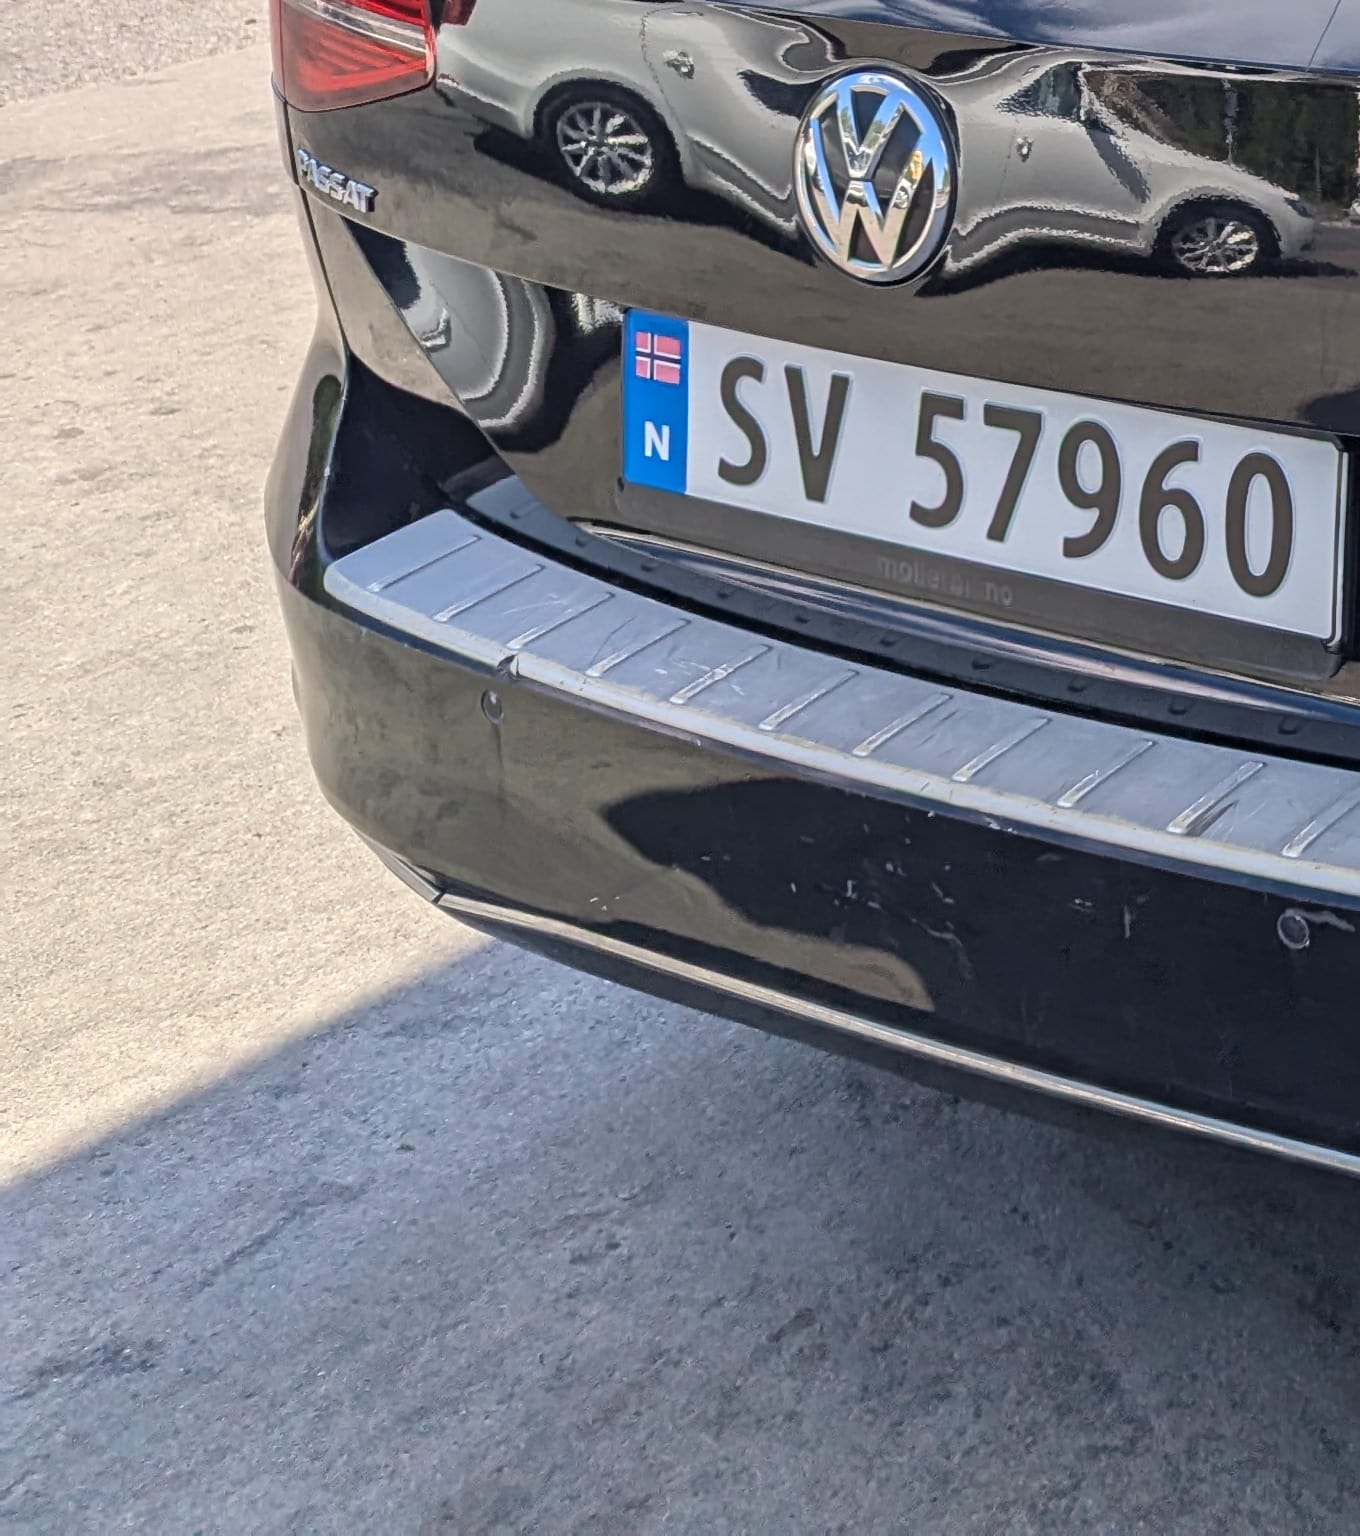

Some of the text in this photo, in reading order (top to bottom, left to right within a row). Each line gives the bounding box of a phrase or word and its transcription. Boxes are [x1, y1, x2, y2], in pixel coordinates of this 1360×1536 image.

[297, 148, 379, 213] PASSAT
[643, 420, 670, 462] N
[716, 354, 1294, 598] SV 57960
